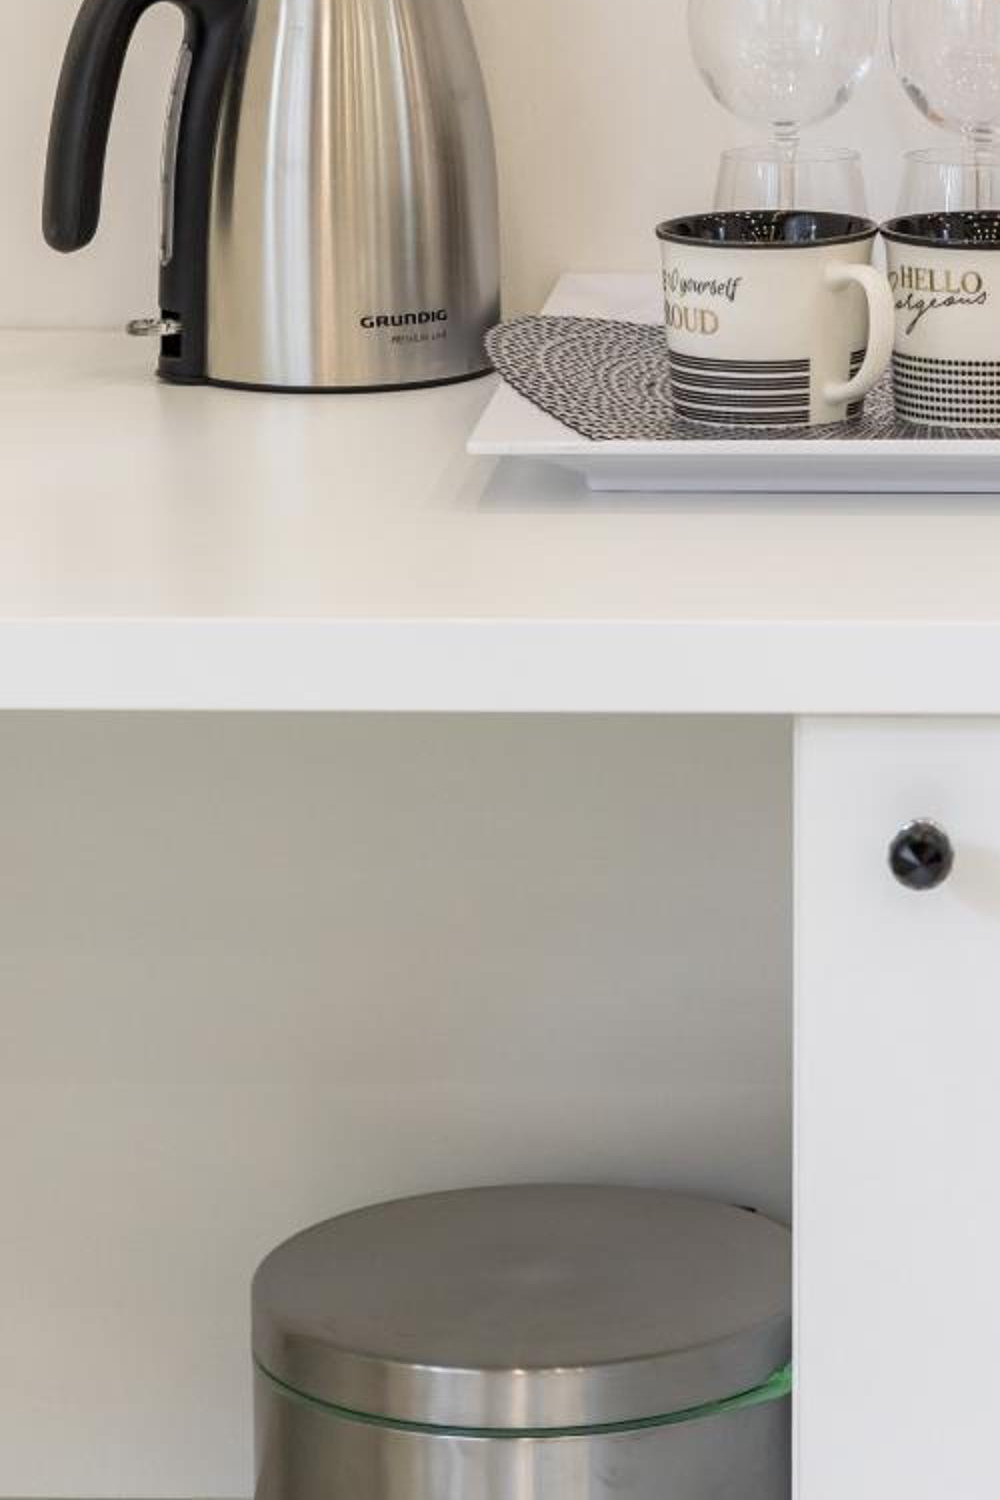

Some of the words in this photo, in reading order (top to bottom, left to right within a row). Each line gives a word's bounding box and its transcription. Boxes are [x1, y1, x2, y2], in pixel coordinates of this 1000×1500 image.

[680, 275, 743, 302] yourself
[900, 264, 983, 294] HELLO
[360, 309, 448, 329] GRUNDIG
[894, 291, 987, 335] orgeous
